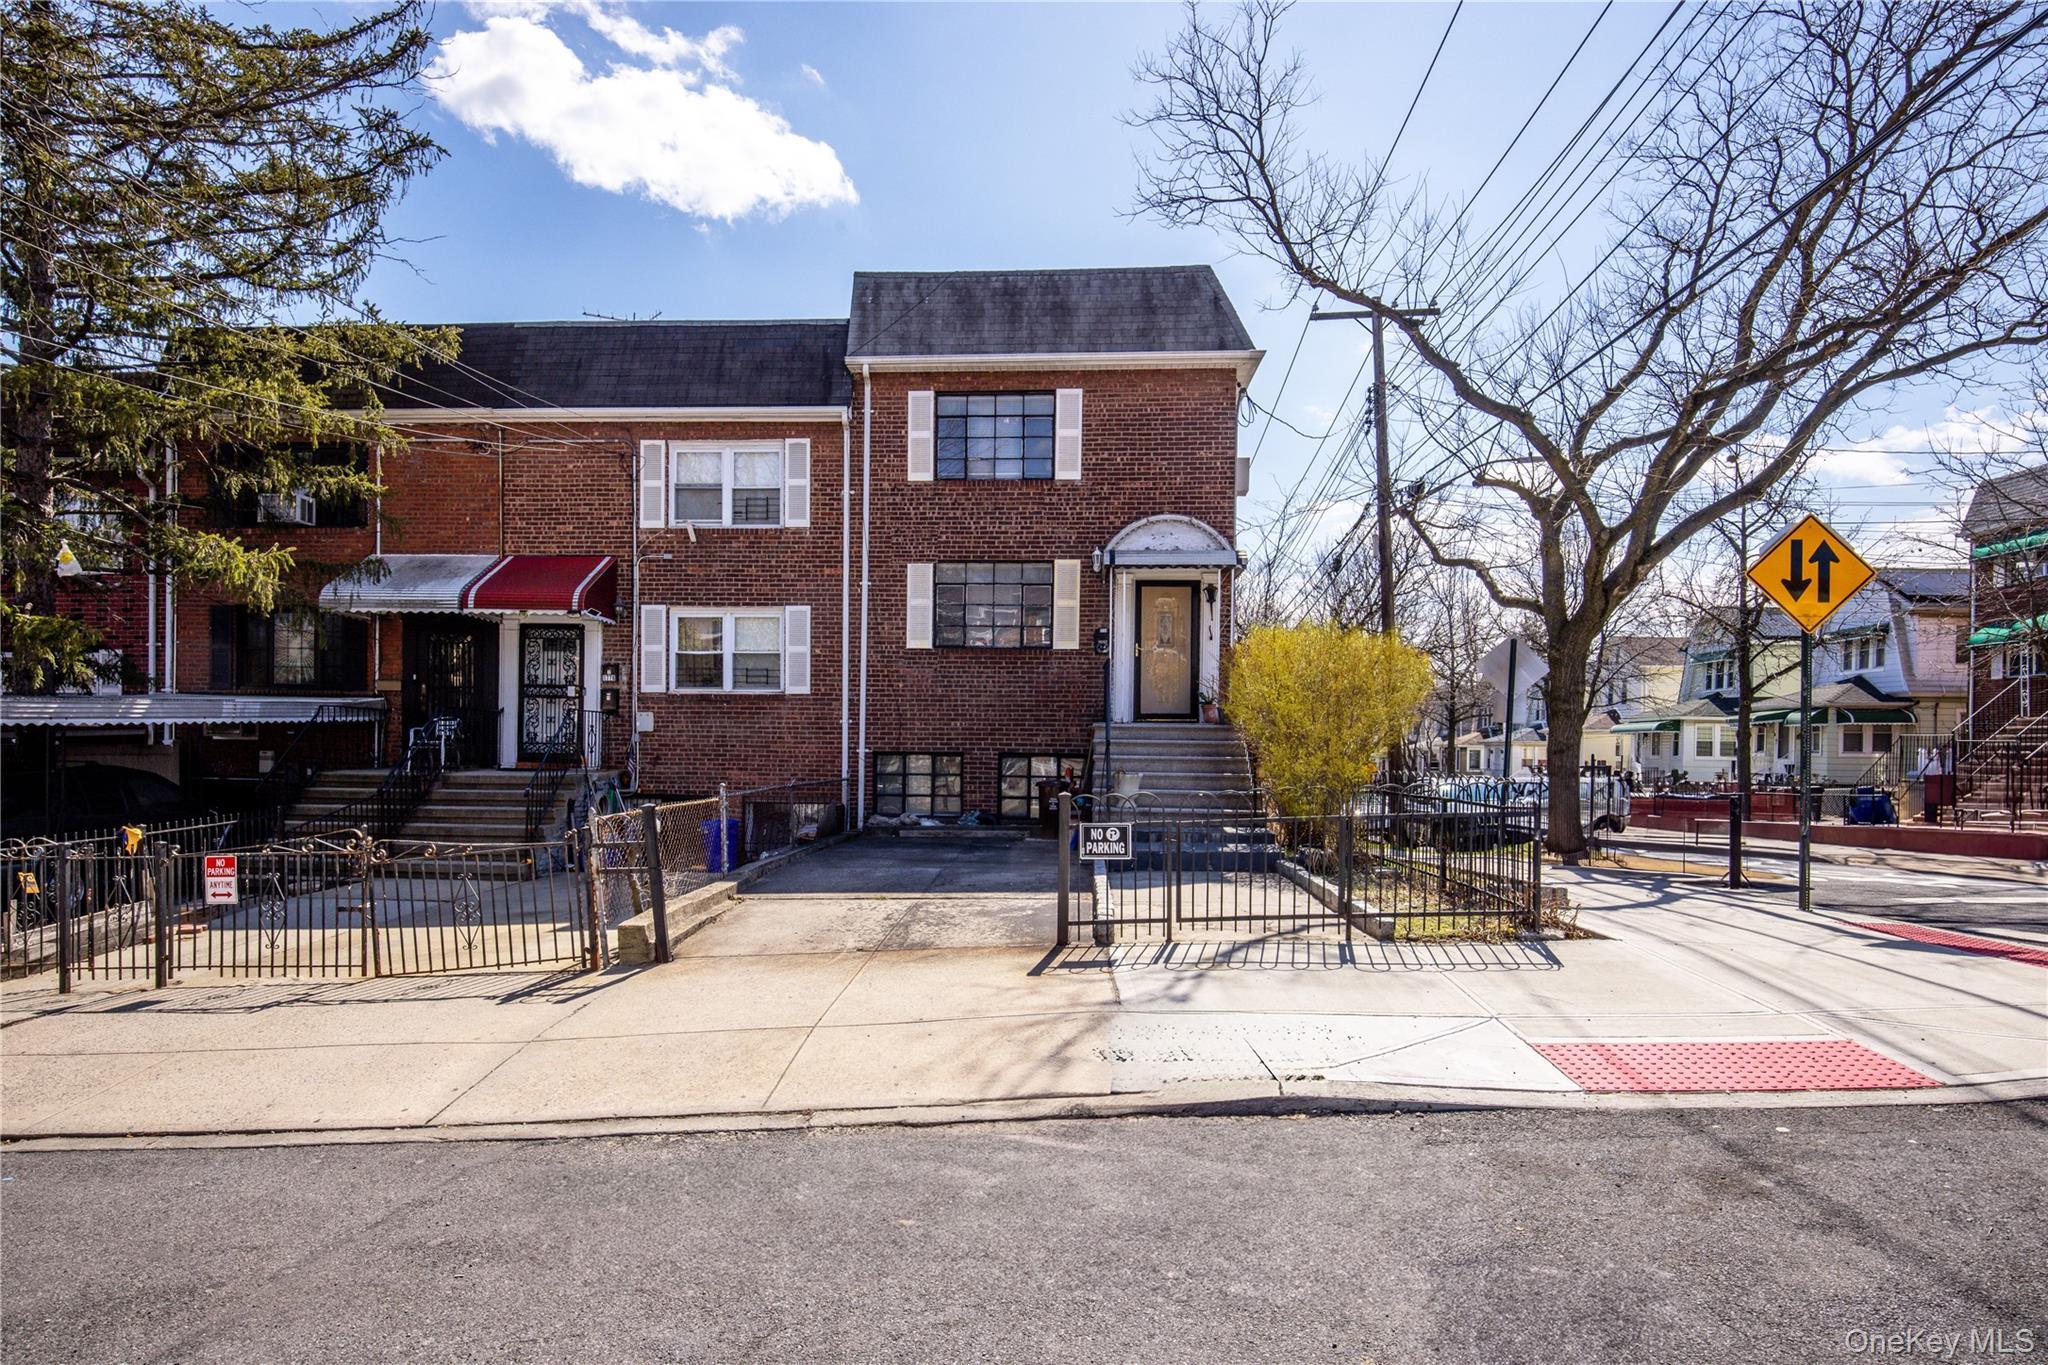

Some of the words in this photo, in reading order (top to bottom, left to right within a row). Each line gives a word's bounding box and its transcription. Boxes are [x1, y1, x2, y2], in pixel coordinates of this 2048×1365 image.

[1090, 828, 1103, 840] NO
[1086, 842, 1125, 854] PARKING
[215, 858, 226, 867] NO
[207, 867, 235, 876] PARKING
[209, 881, 233, 889] ANYTIME
